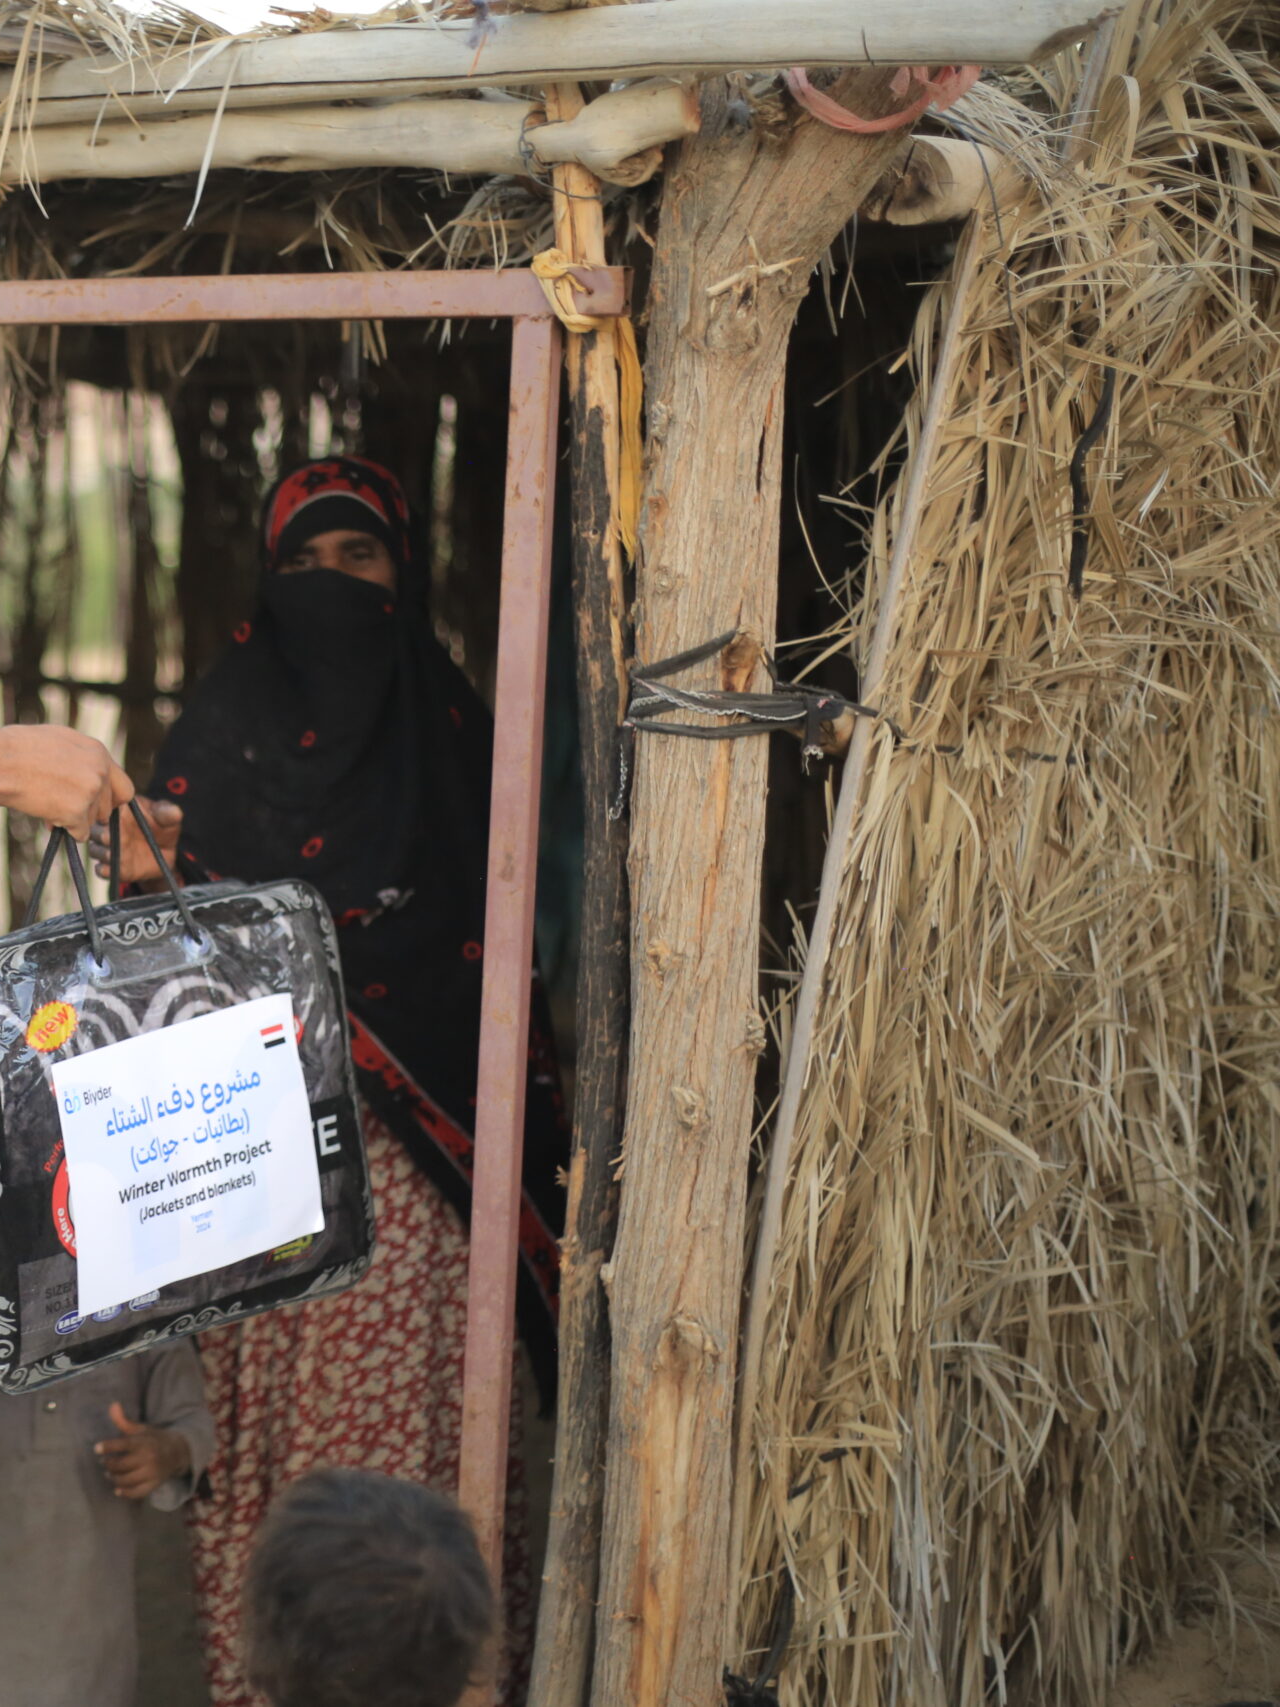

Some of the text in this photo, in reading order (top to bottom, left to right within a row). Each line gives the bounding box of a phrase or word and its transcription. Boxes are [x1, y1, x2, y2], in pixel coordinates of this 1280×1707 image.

[34, 1006, 68, 1043] new
[83, 1085, 112, 1106] Biyder
[106, 1069, 261, 1136] مشروع دفء الشتاء
[312, 1114, 342, 1156] E
[118, 1140, 272, 1204] Winter Warmth Project
[139, 1171, 256, 1224] (Jackets and blankets)
